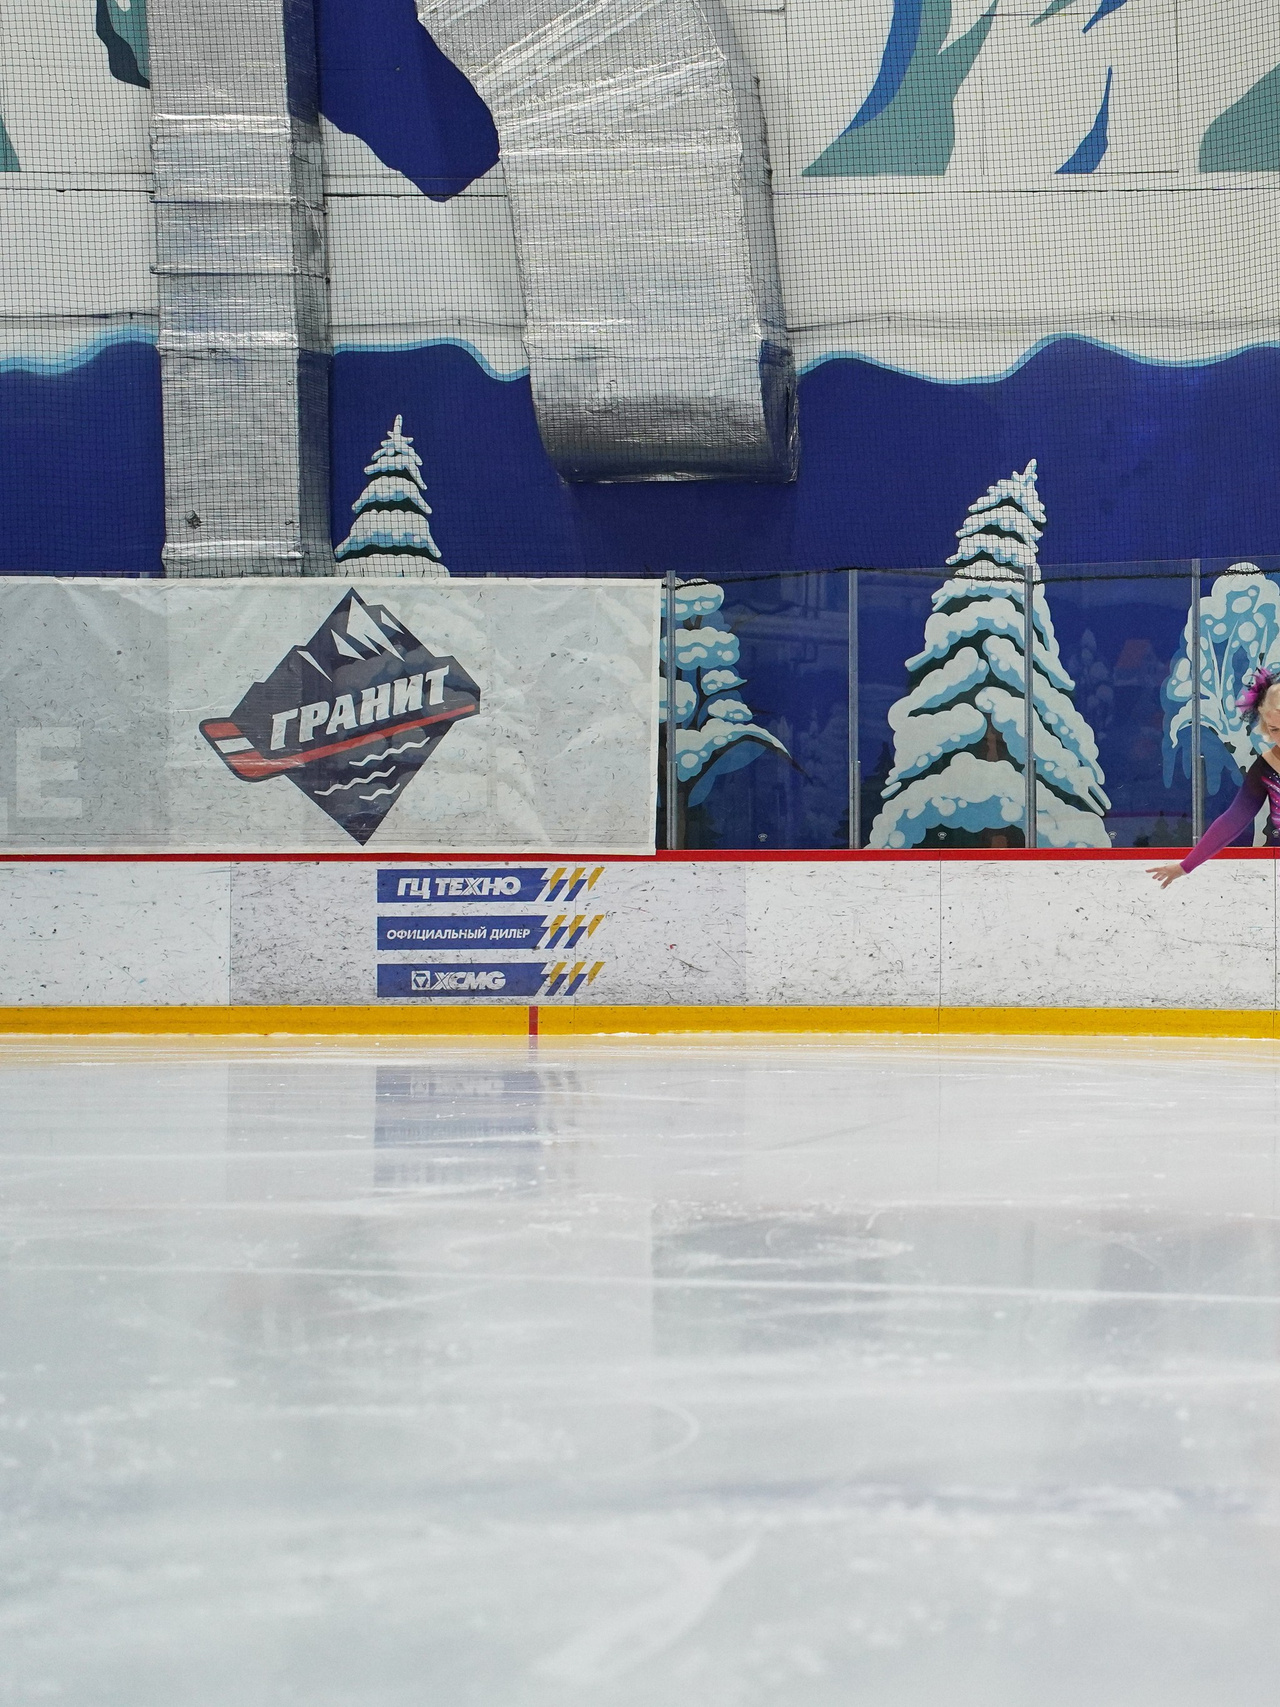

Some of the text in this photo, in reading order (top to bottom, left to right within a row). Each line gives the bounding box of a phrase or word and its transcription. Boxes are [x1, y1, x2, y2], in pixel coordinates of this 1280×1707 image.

[270, 665, 450, 751] ГРАНИТ
[397, 876, 522, 899] ГЦ ТЕХНО
[386, 926, 531, 941] ОФИЦИАЛЬНЫЙ ДИЛЕР
[431, 971, 506, 991] XCMG
